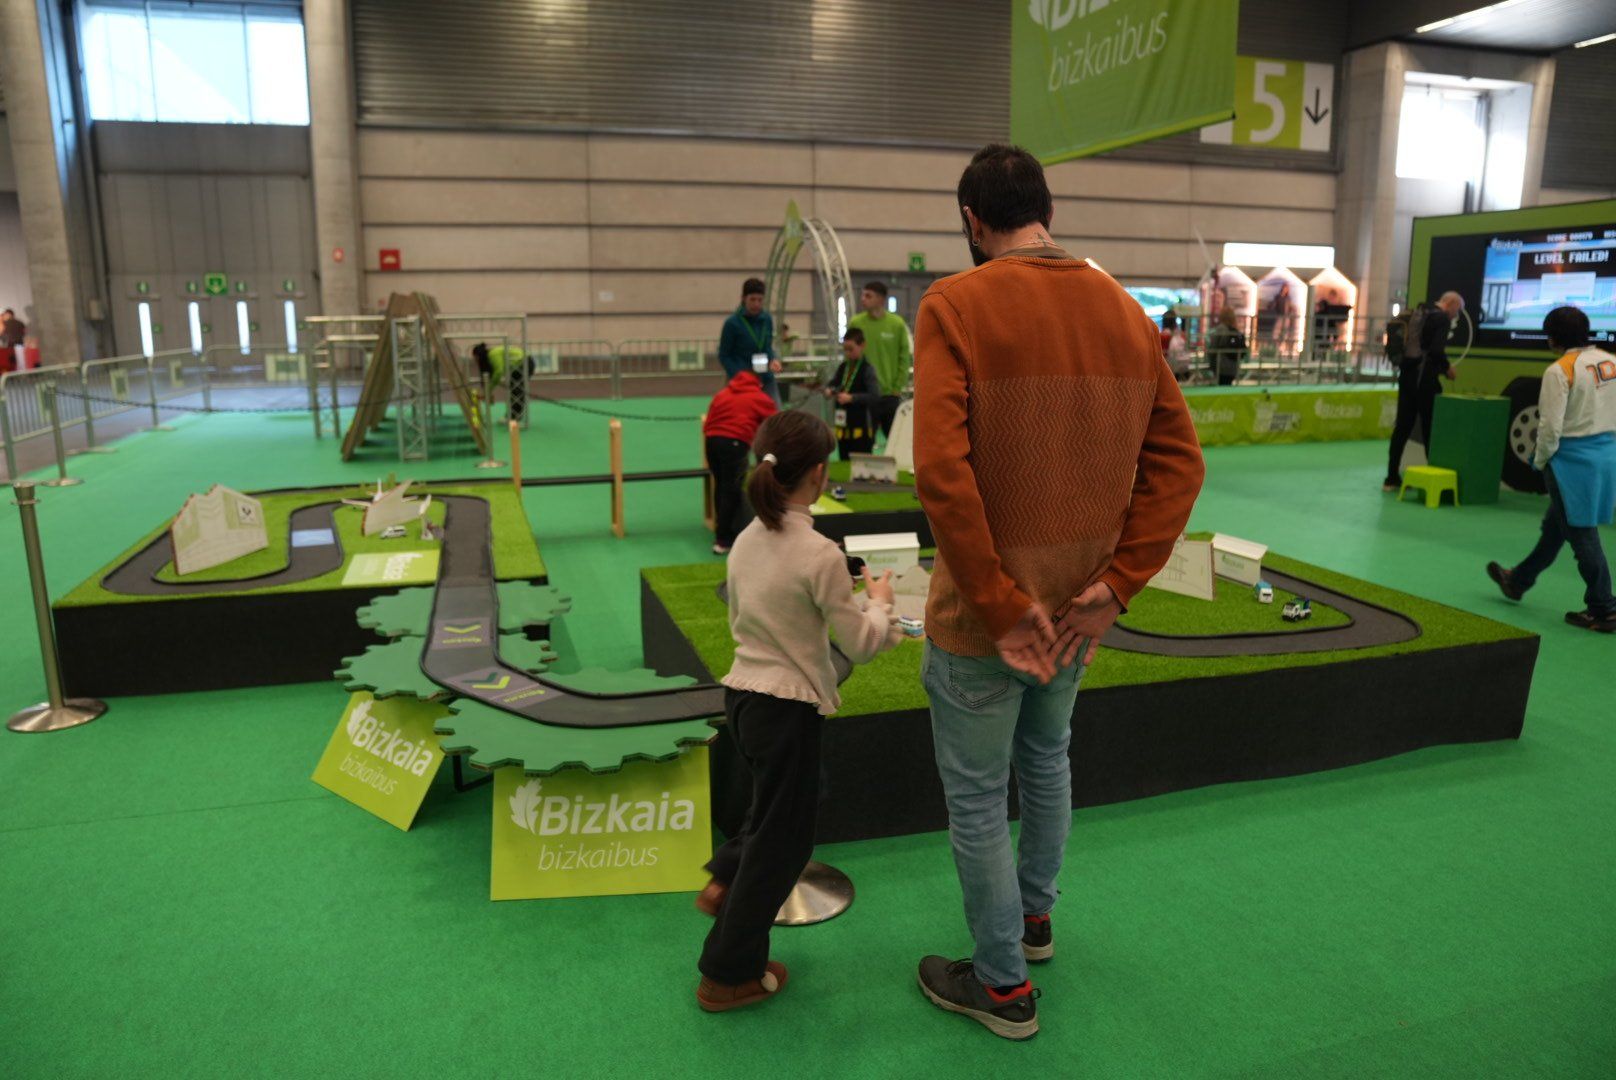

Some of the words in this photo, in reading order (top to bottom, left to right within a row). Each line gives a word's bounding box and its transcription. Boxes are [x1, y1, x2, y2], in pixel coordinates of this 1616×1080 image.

[1048, 11, 1169, 92] bizkaibus
[1249, 60, 1286, 143] 5
[1534, 252, 1564, 265] LEVEL
[1568, 249, 1609, 263] FAILED!
[352, 716, 434, 776] Bizkaia
[339, 752, 398, 795] bizkaibus
[539, 791, 695, 836] Bizkaia
[538, 841, 659, 871] bizkaibus
